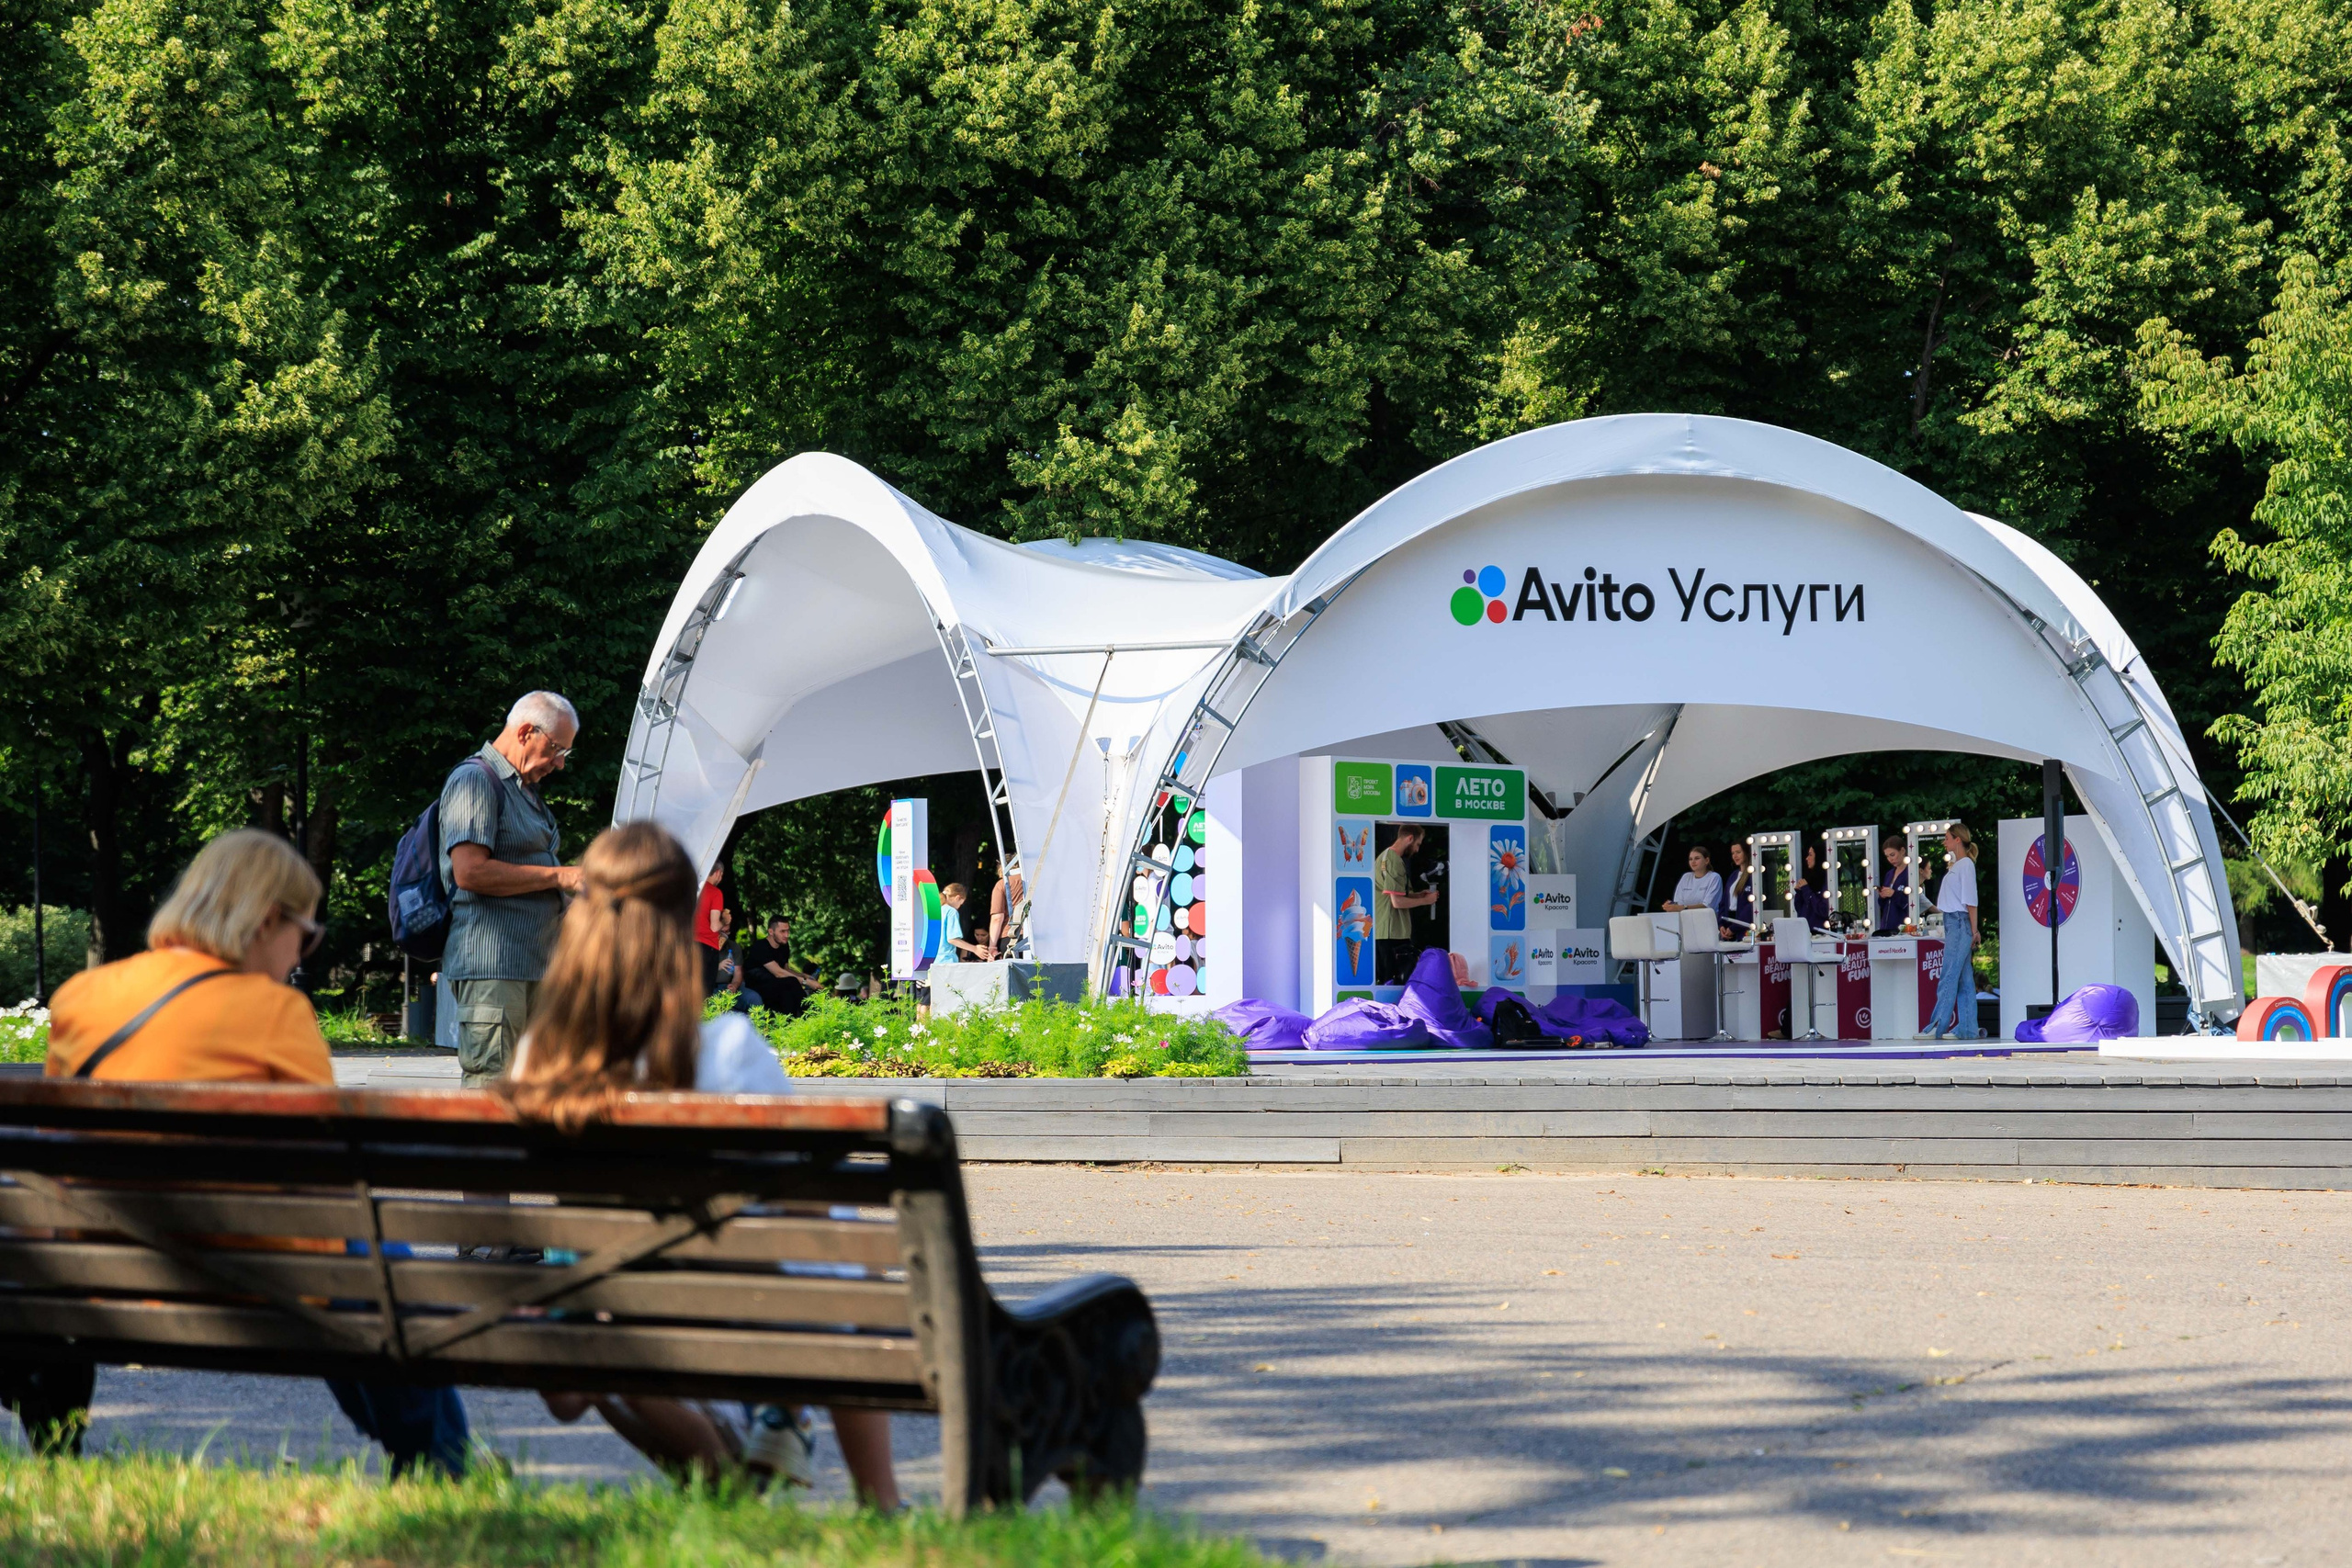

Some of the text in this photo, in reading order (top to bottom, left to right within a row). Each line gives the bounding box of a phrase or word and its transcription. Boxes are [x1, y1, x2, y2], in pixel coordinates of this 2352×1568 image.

[1512, 566, 1865, 636] Avito Услуги
[1455, 777, 1506, 797] ЛЕТО
[1455, 799, 1506, 810] В МОСКВЕ
[1544, 893, 1571, 903] Avito
[1538, 948, 1554, 959] Avito
[1573, 947, 1600, 958] Avito
[1926, 948, 1944, 960] MAK
[1848, 966, 1870, 982] FUN
[1929, 967, 1942, 981] FU
